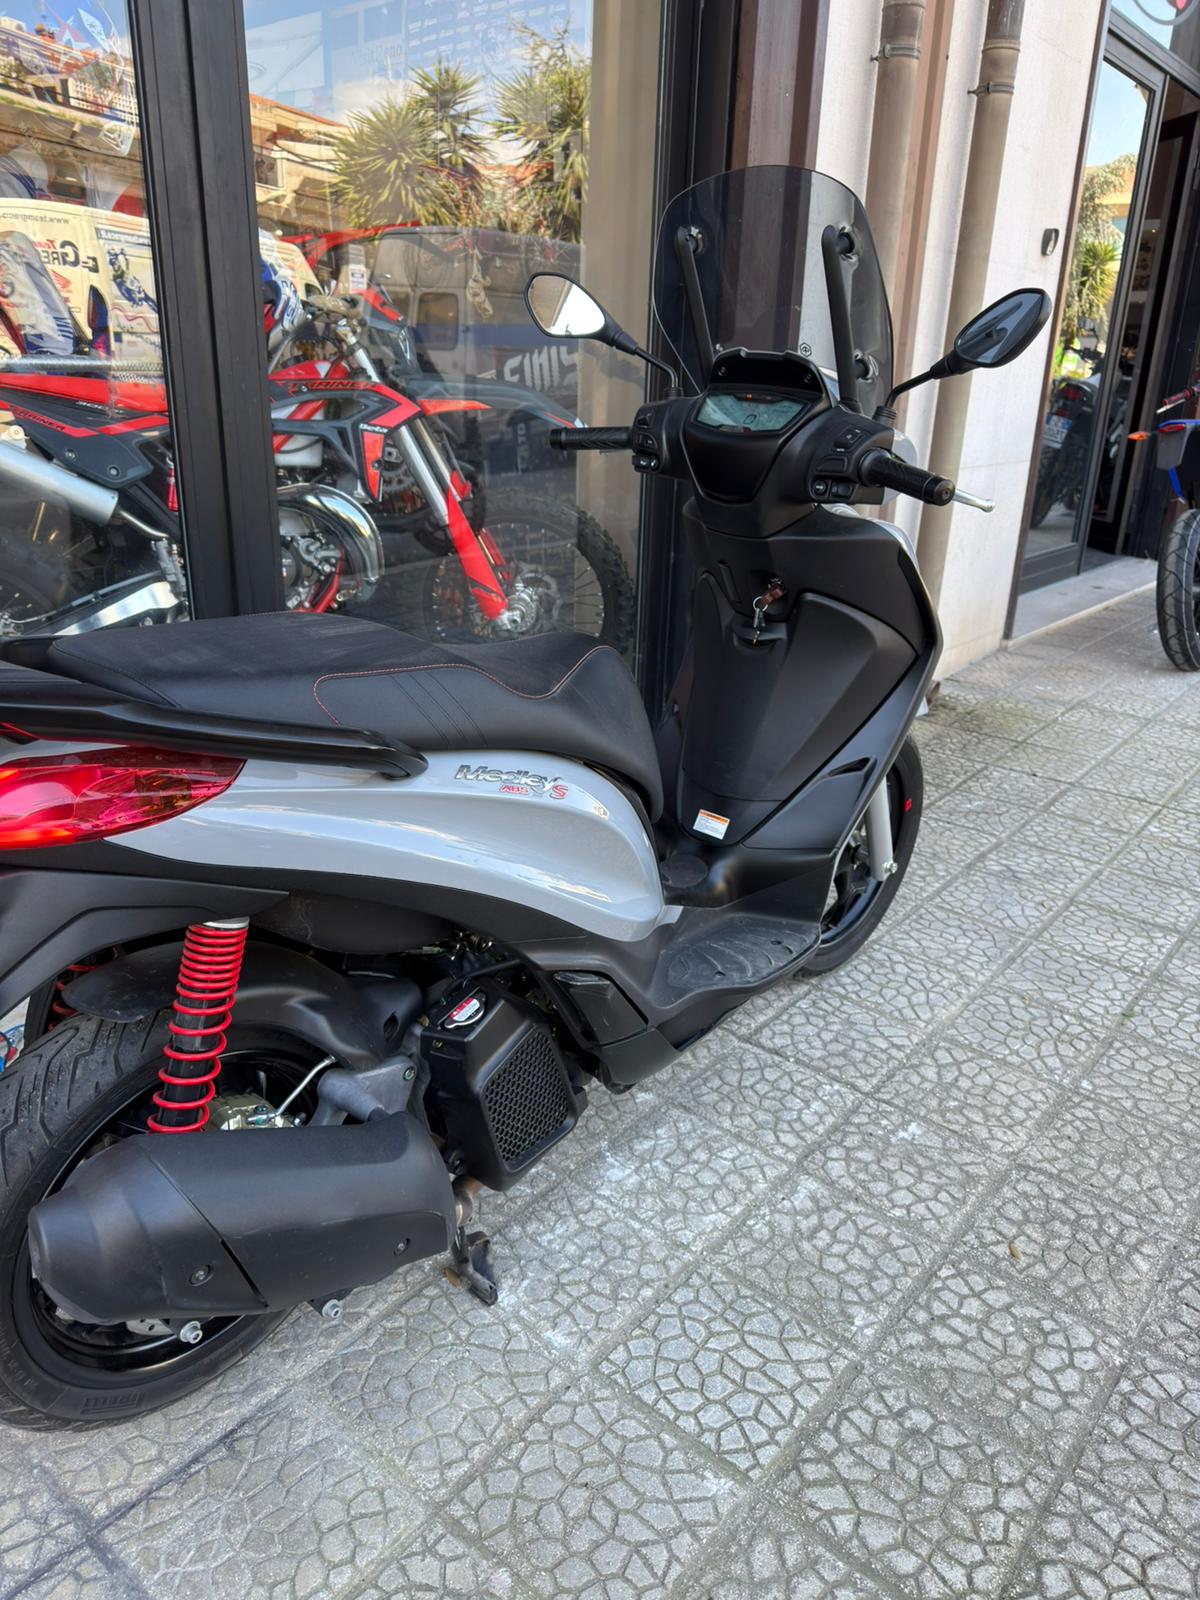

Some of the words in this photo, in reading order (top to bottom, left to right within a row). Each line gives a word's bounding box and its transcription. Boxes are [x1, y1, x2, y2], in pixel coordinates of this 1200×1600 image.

[454, 764, 563, 795] Medley
[549, 784, 569, 800] S
[499, 784, 529, 795] ABS
